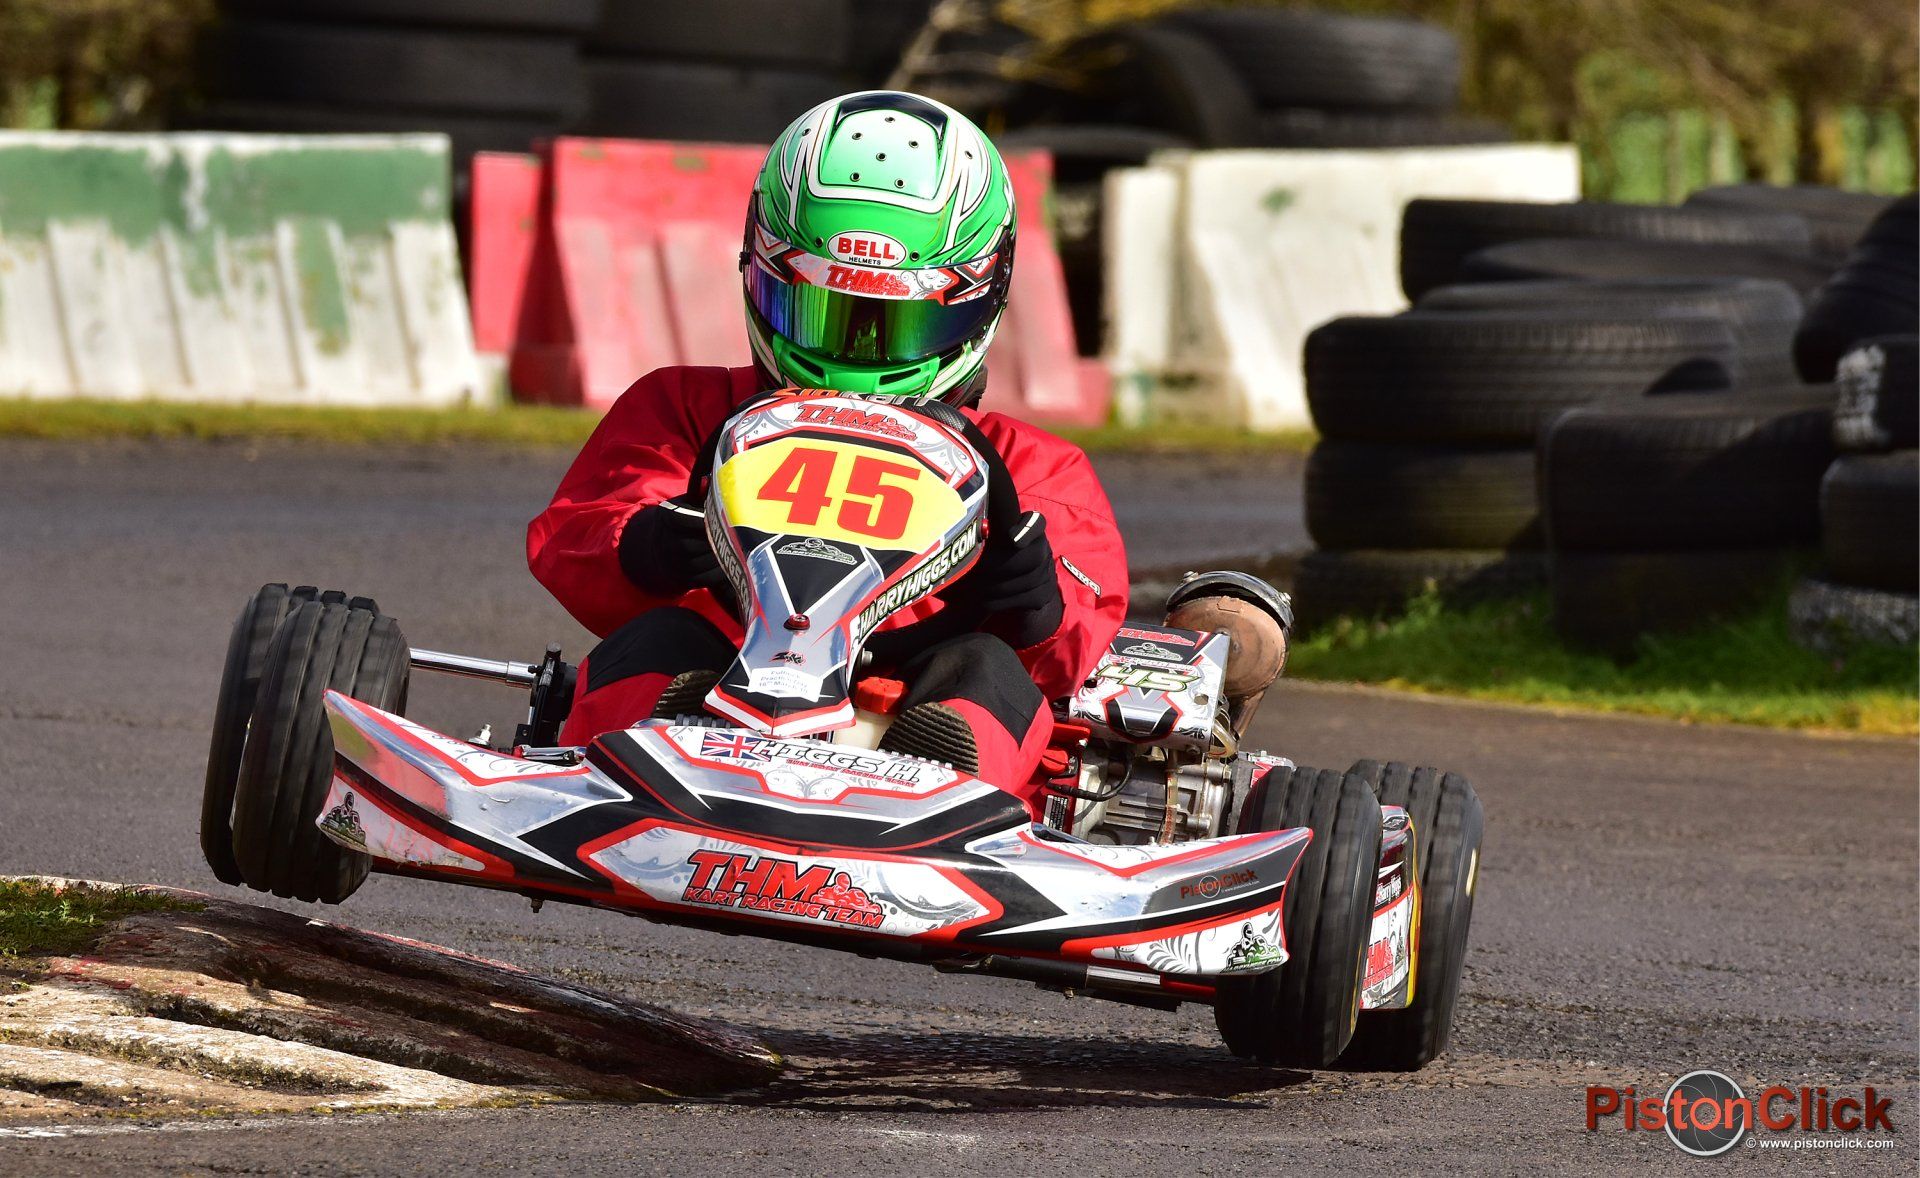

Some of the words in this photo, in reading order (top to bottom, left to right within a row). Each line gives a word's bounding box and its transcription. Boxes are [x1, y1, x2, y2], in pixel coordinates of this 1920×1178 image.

[838, 237, 895, 260] BELL
[848, 256, 882, 266] HELMETS
[795, 403, 888, 427] THM
[757, 447, 921, 540] 45
[859, 519, 978, 641] HARRYHIGGS.COM
[751, 740, 885, 773] HIGGS
[884, 762, 920, 783] H.
[688, 849, 835, 901] THM
[1180, 867, 1258, 899] PistonClick
[683, 887, 739, 906] KART
[739, 894, 821, 919] RACING
[823, 906, 886, 928] TEAM
